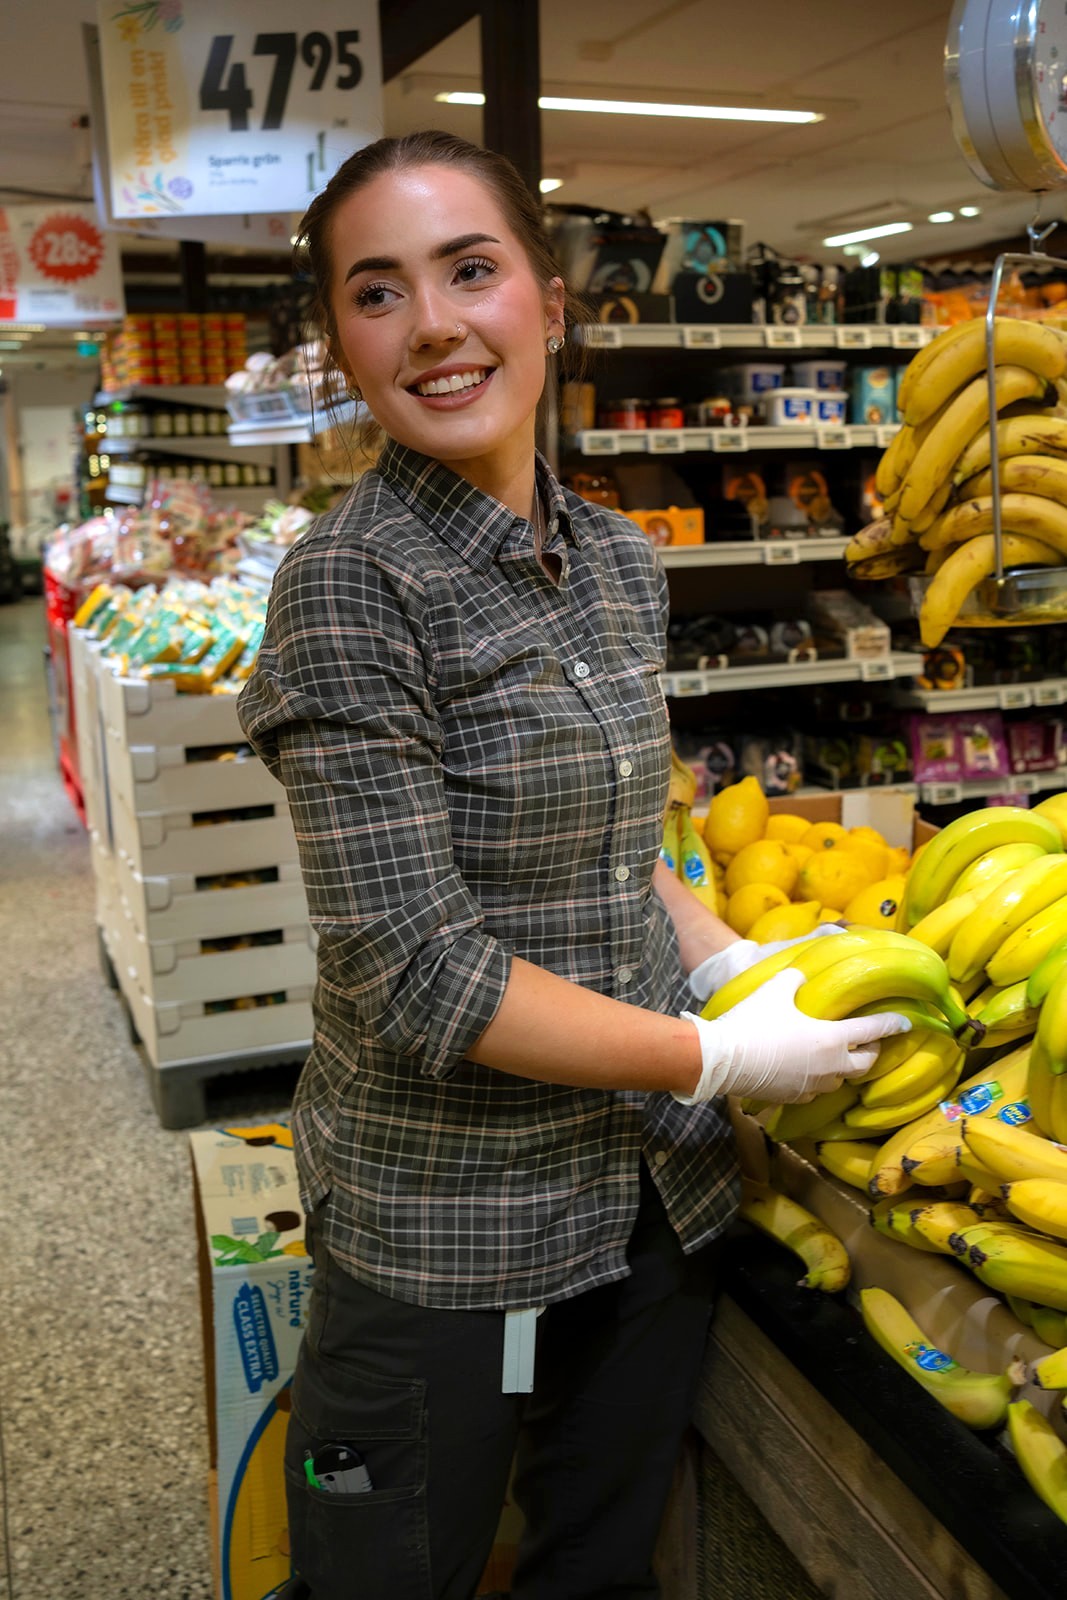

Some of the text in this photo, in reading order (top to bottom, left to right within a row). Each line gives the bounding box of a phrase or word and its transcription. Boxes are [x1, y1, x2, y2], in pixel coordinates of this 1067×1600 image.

[250, 1293, 274, 1377] SELECTED QUALITY
[288, 1270, 304, 1328] nature
[237, 1300, 263, 1380] CLASS EXTRA
